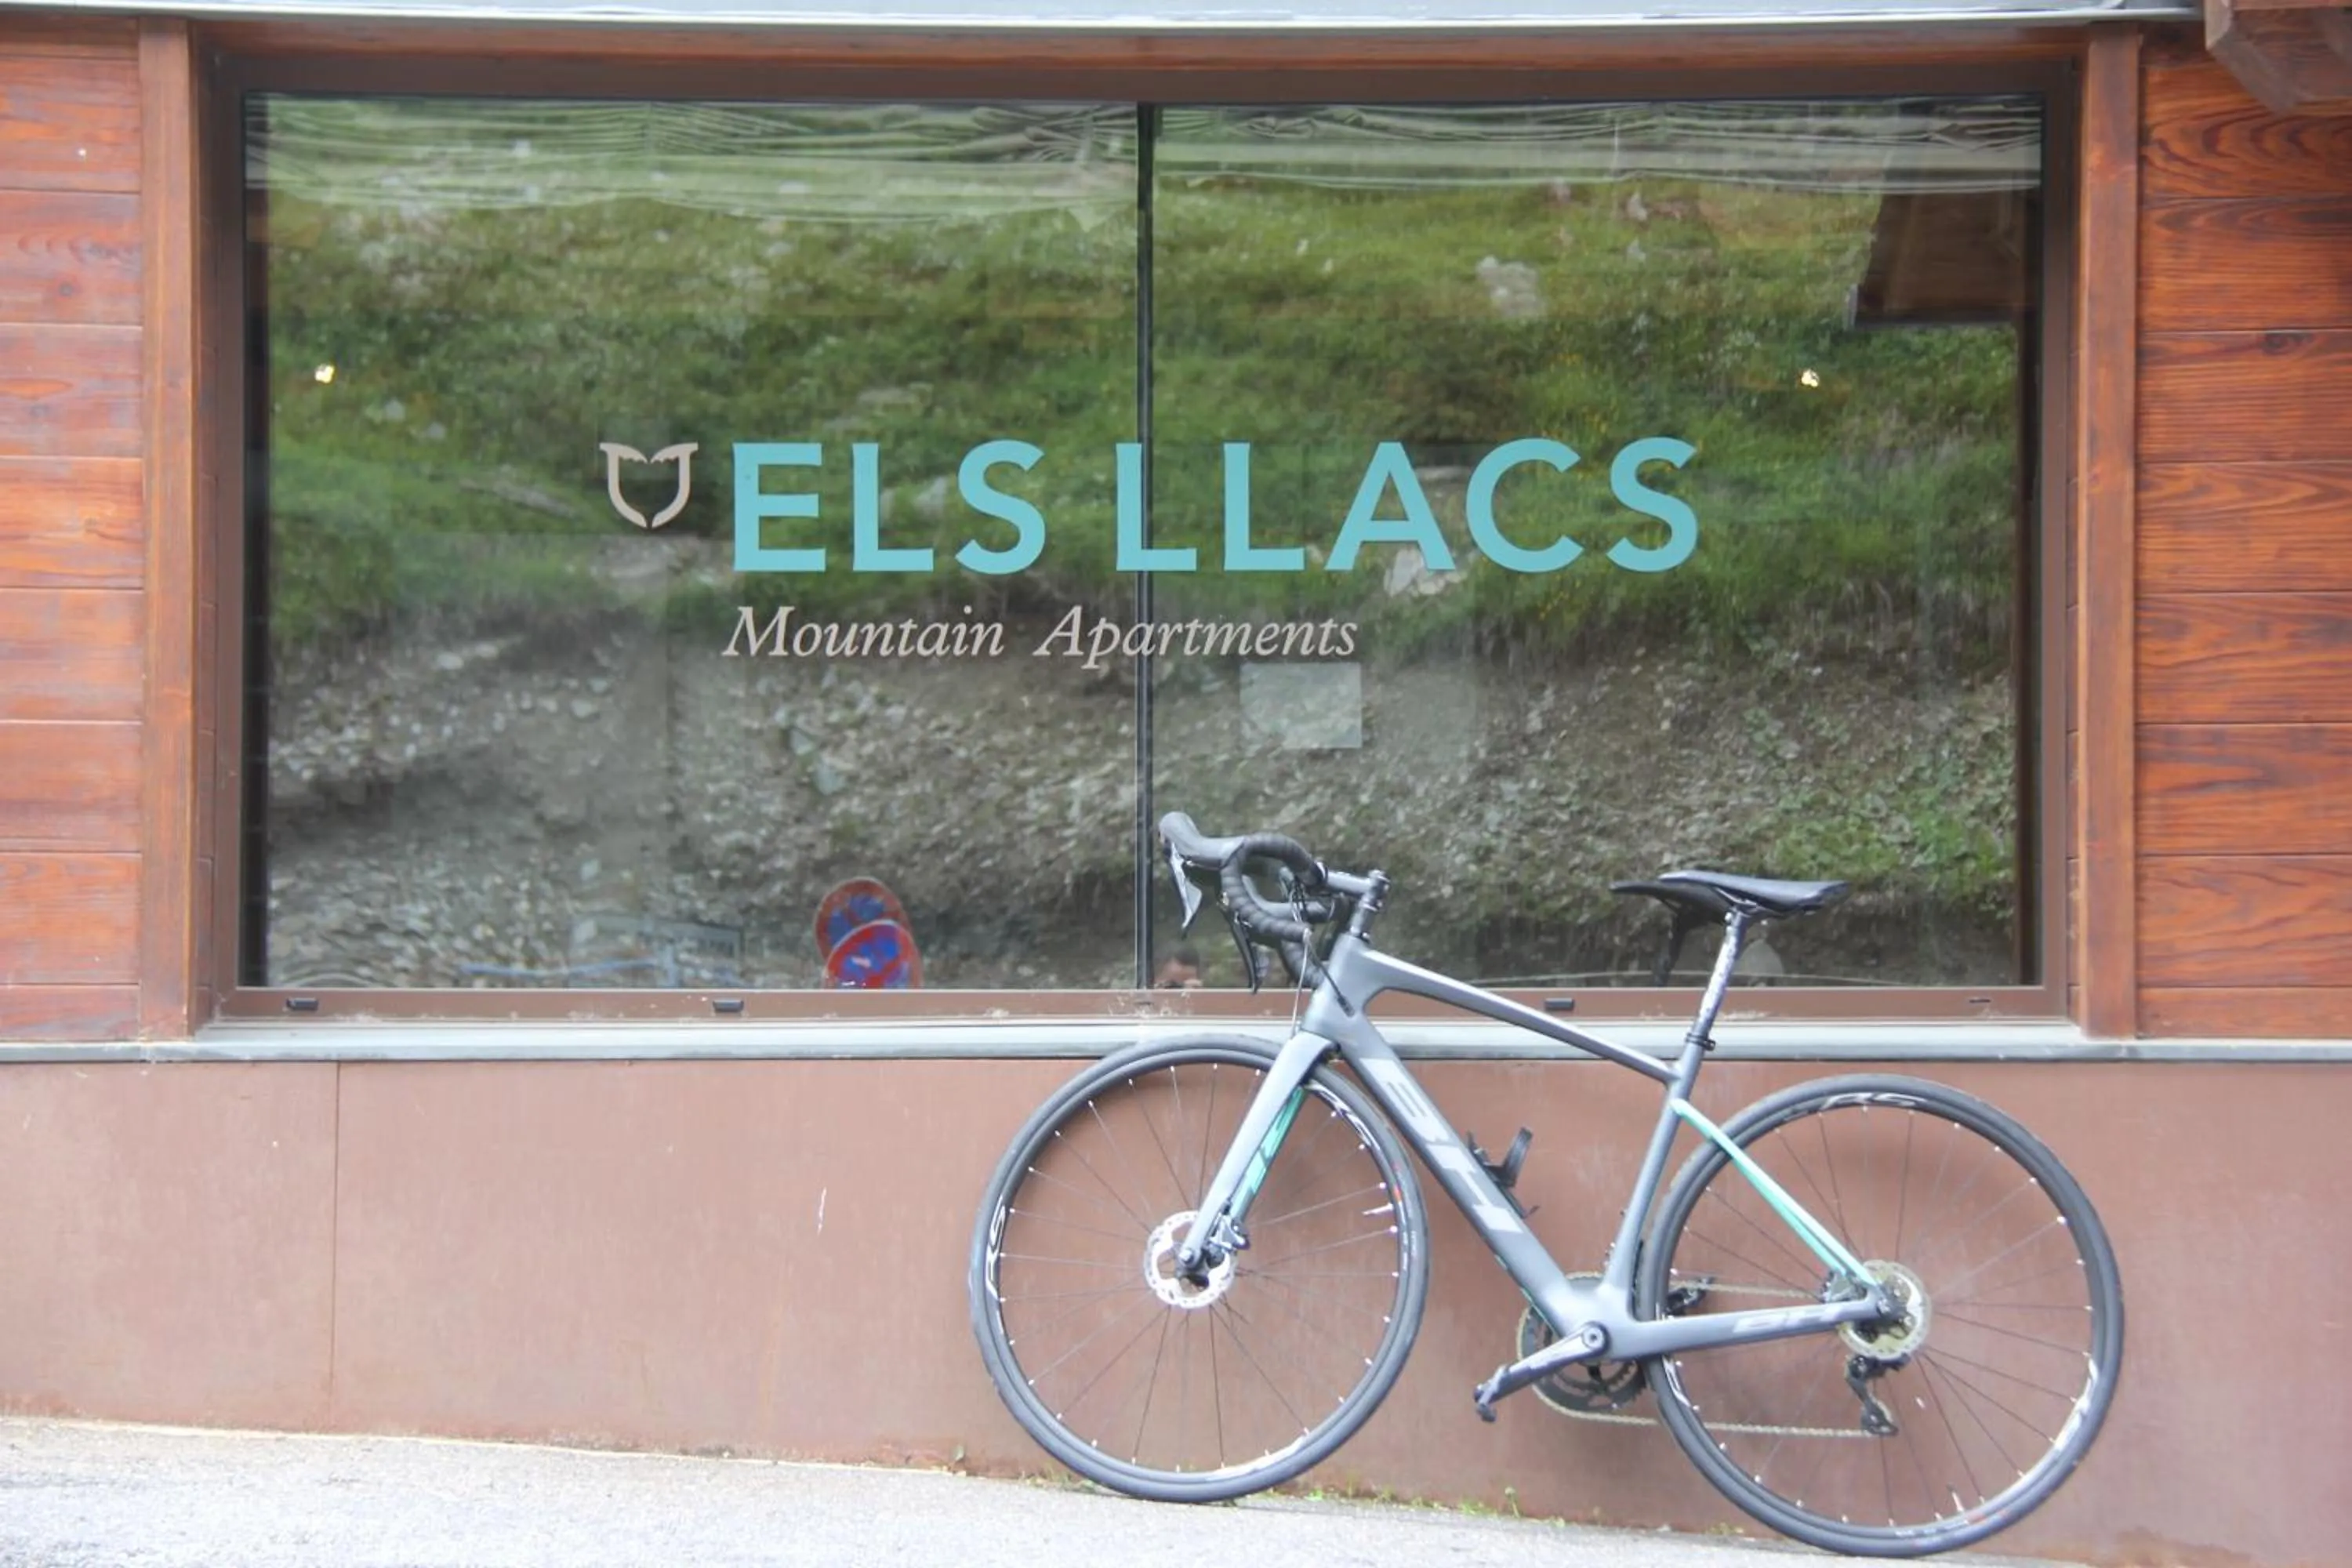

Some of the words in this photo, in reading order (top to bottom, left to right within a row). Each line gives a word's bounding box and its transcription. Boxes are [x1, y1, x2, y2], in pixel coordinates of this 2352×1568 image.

[732, 439, 1046, 575] ELS
[1116, 437, 1698, 572] LLACS
[722, 605, 1004, 657] Mountain
[1032, 604, 1358, 670] Apartments
